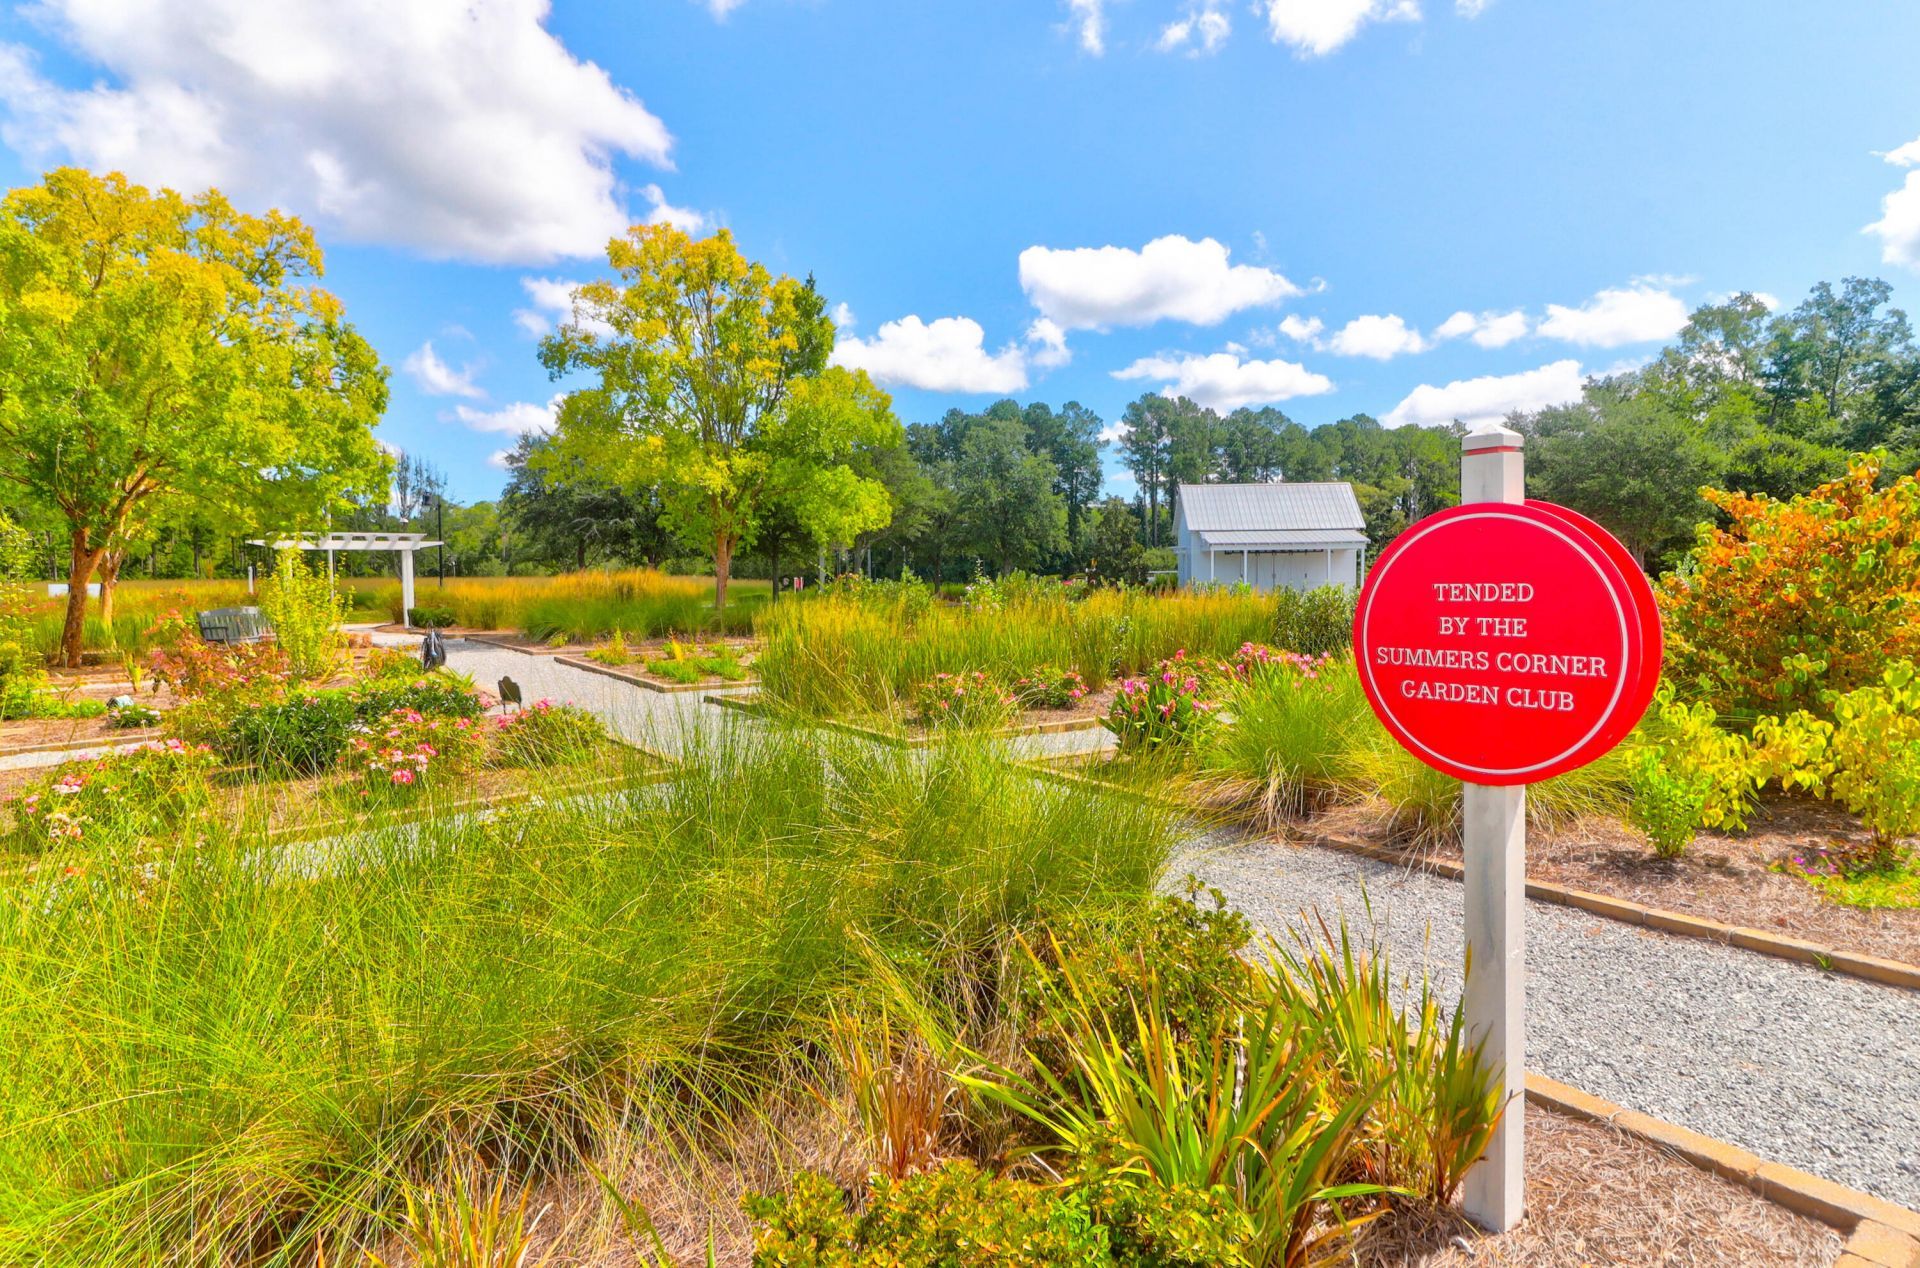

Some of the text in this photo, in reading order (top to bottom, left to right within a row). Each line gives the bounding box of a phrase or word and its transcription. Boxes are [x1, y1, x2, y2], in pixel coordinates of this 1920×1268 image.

[1433, 583, 1534, 602] TENDED
[1439, 617, 1527, 637] BY THE
[1376, 647, 1607, 678] SUMMERS CORNER
[1401, 681, 1574, 711] GARDEN CLUB
